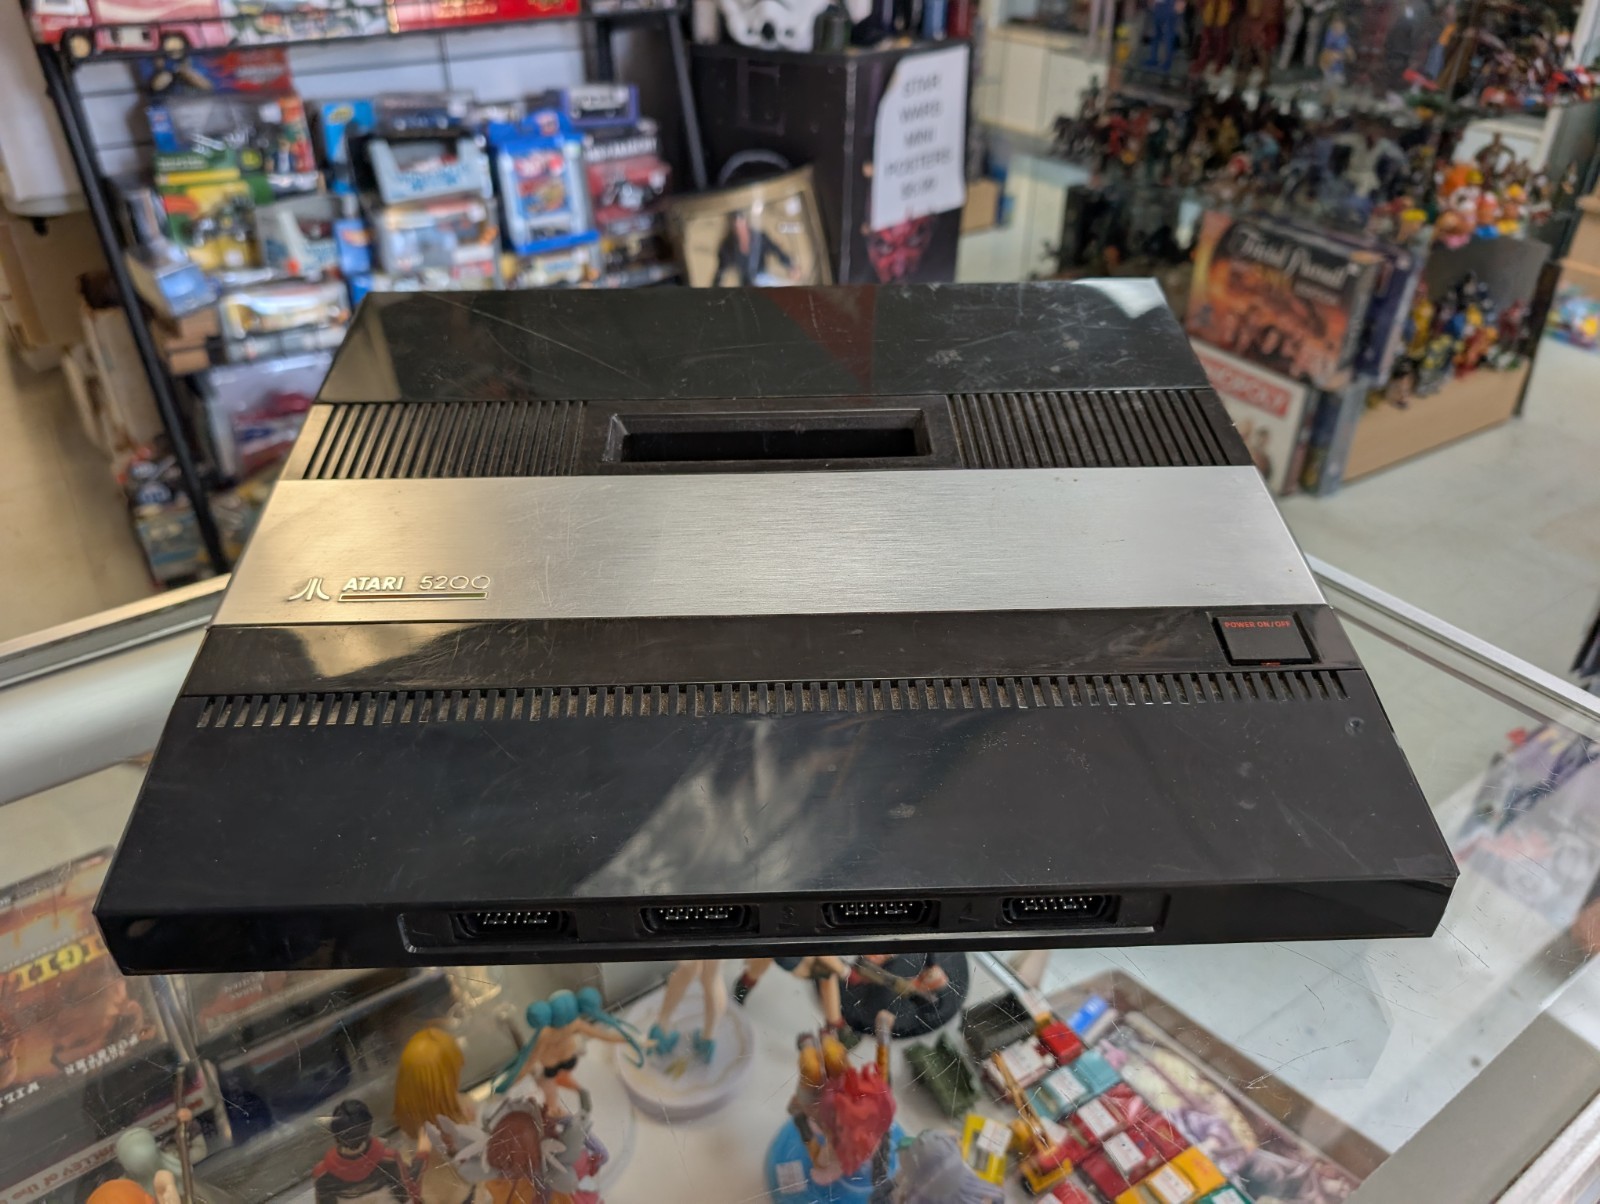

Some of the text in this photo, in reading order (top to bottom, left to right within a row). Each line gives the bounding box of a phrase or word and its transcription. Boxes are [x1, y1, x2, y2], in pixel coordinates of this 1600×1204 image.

[342, 575, 491, 592] ATARI 5200
[1224, 620, 1291, 629] POWER ON/OFF
[7, 933, 109, 992] IGIL
